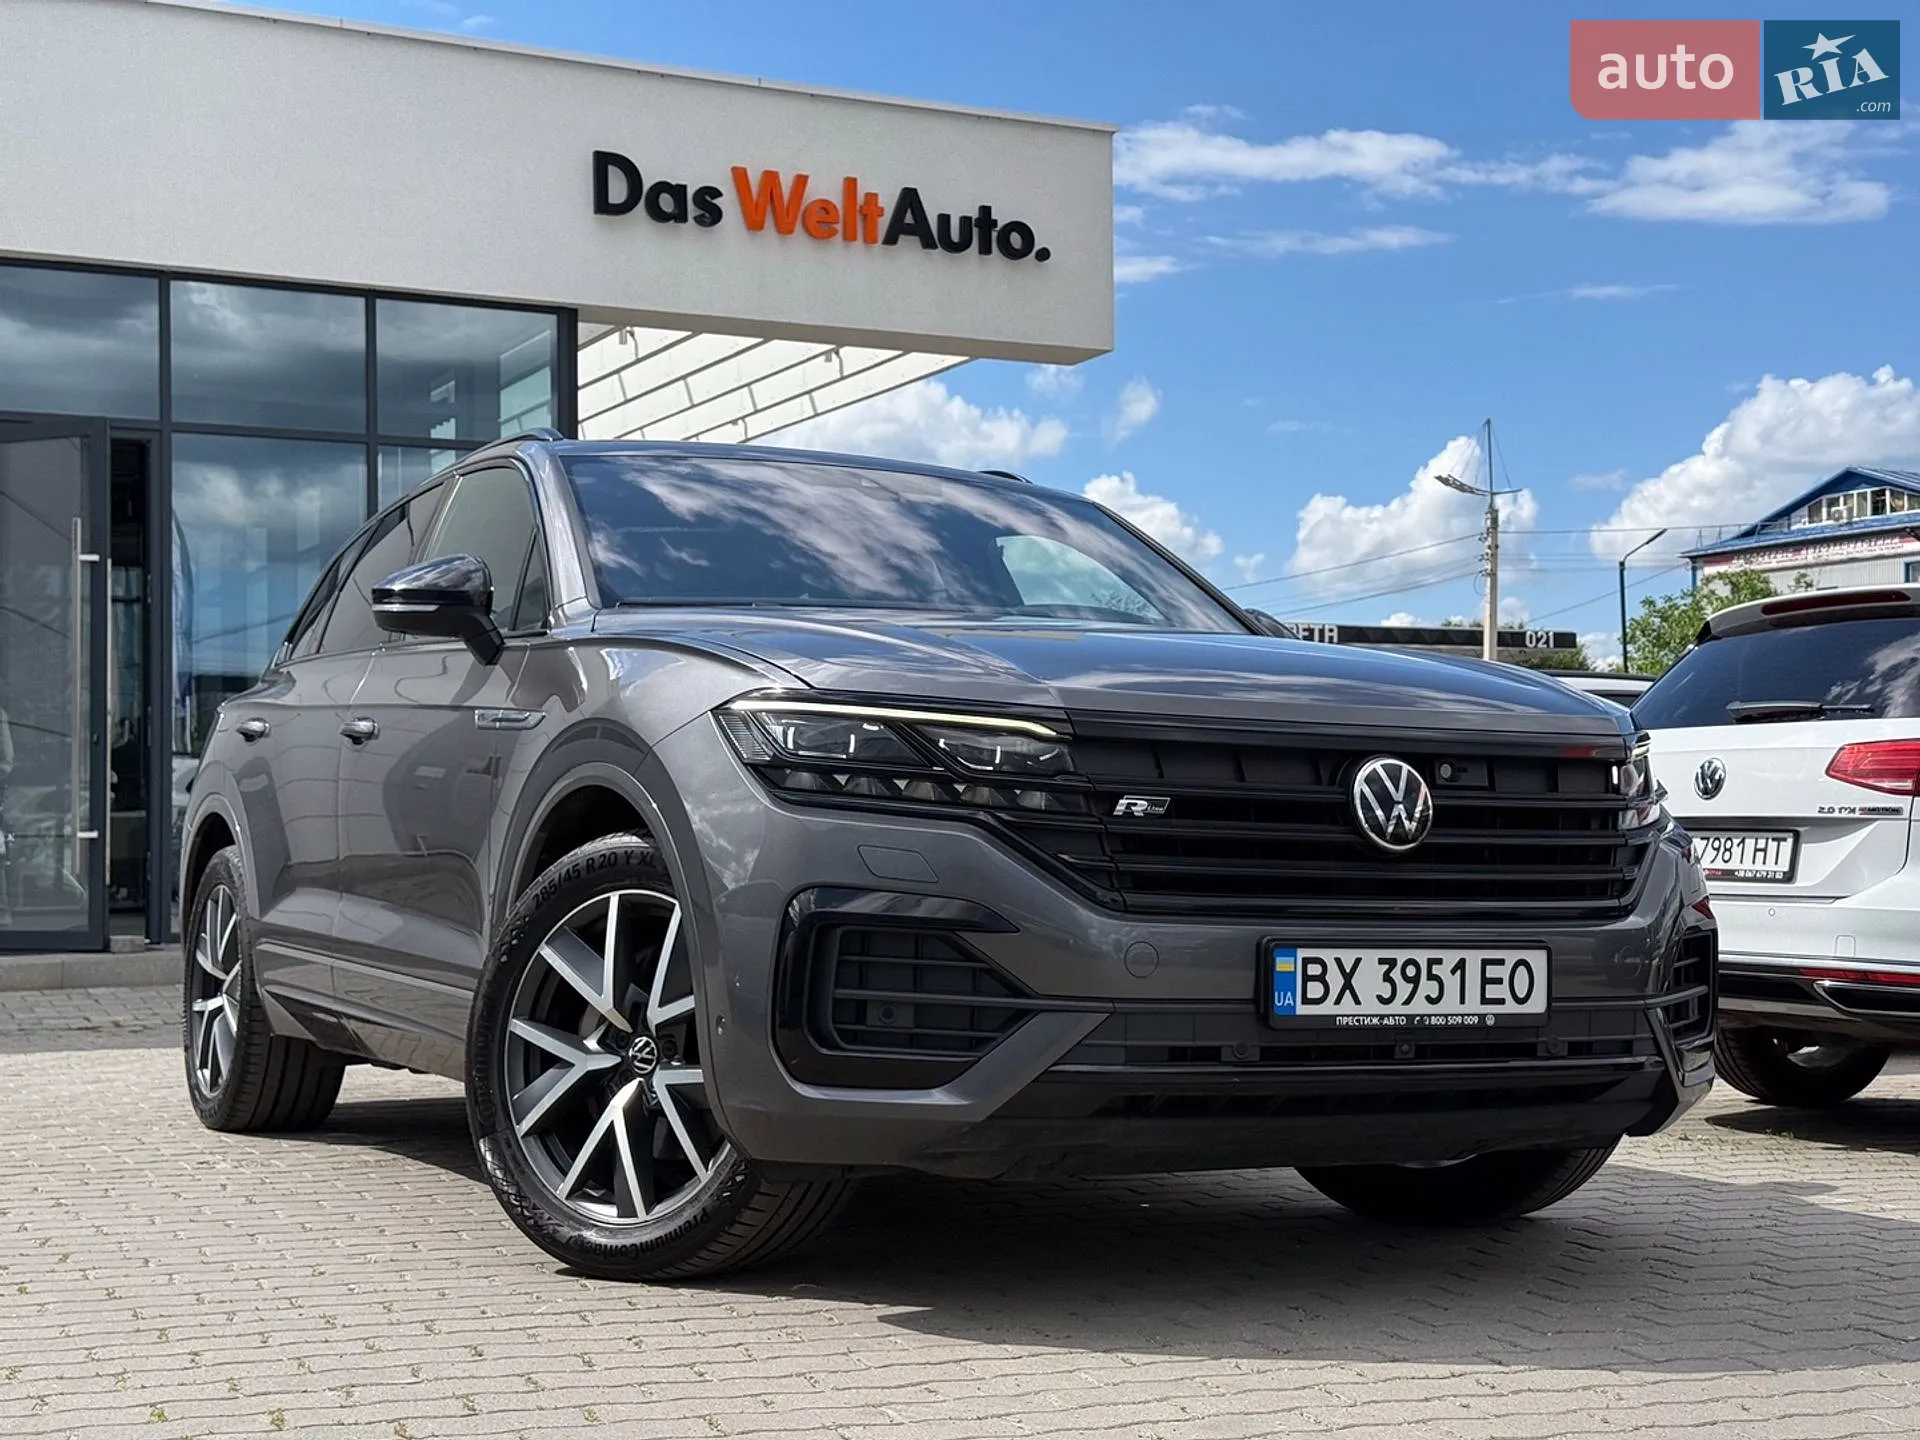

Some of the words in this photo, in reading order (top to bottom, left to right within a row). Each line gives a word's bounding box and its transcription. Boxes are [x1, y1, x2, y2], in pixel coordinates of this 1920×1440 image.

[593, 150, 723, 227] Das
[1525, 631, 1554, 648] 021
[1699, 837, 1745, 865] 7981
[1752, 837, 1787, 866] HT
[532, 863, 581, 909] 285/45
[1275, 992, 1294, 1007] UA
[1301, 957, 1363, 1006] BX
[1375, 957, 1467, 1006] 3951
[1480, 957, 1535, 1006] EO
[1336, 1016, 1406, 1026] ПРЕСТИЖ-АВТО
[1430, 1016, 1446, 1026] 800
[1447, 1016, 1462, 1026] 509
